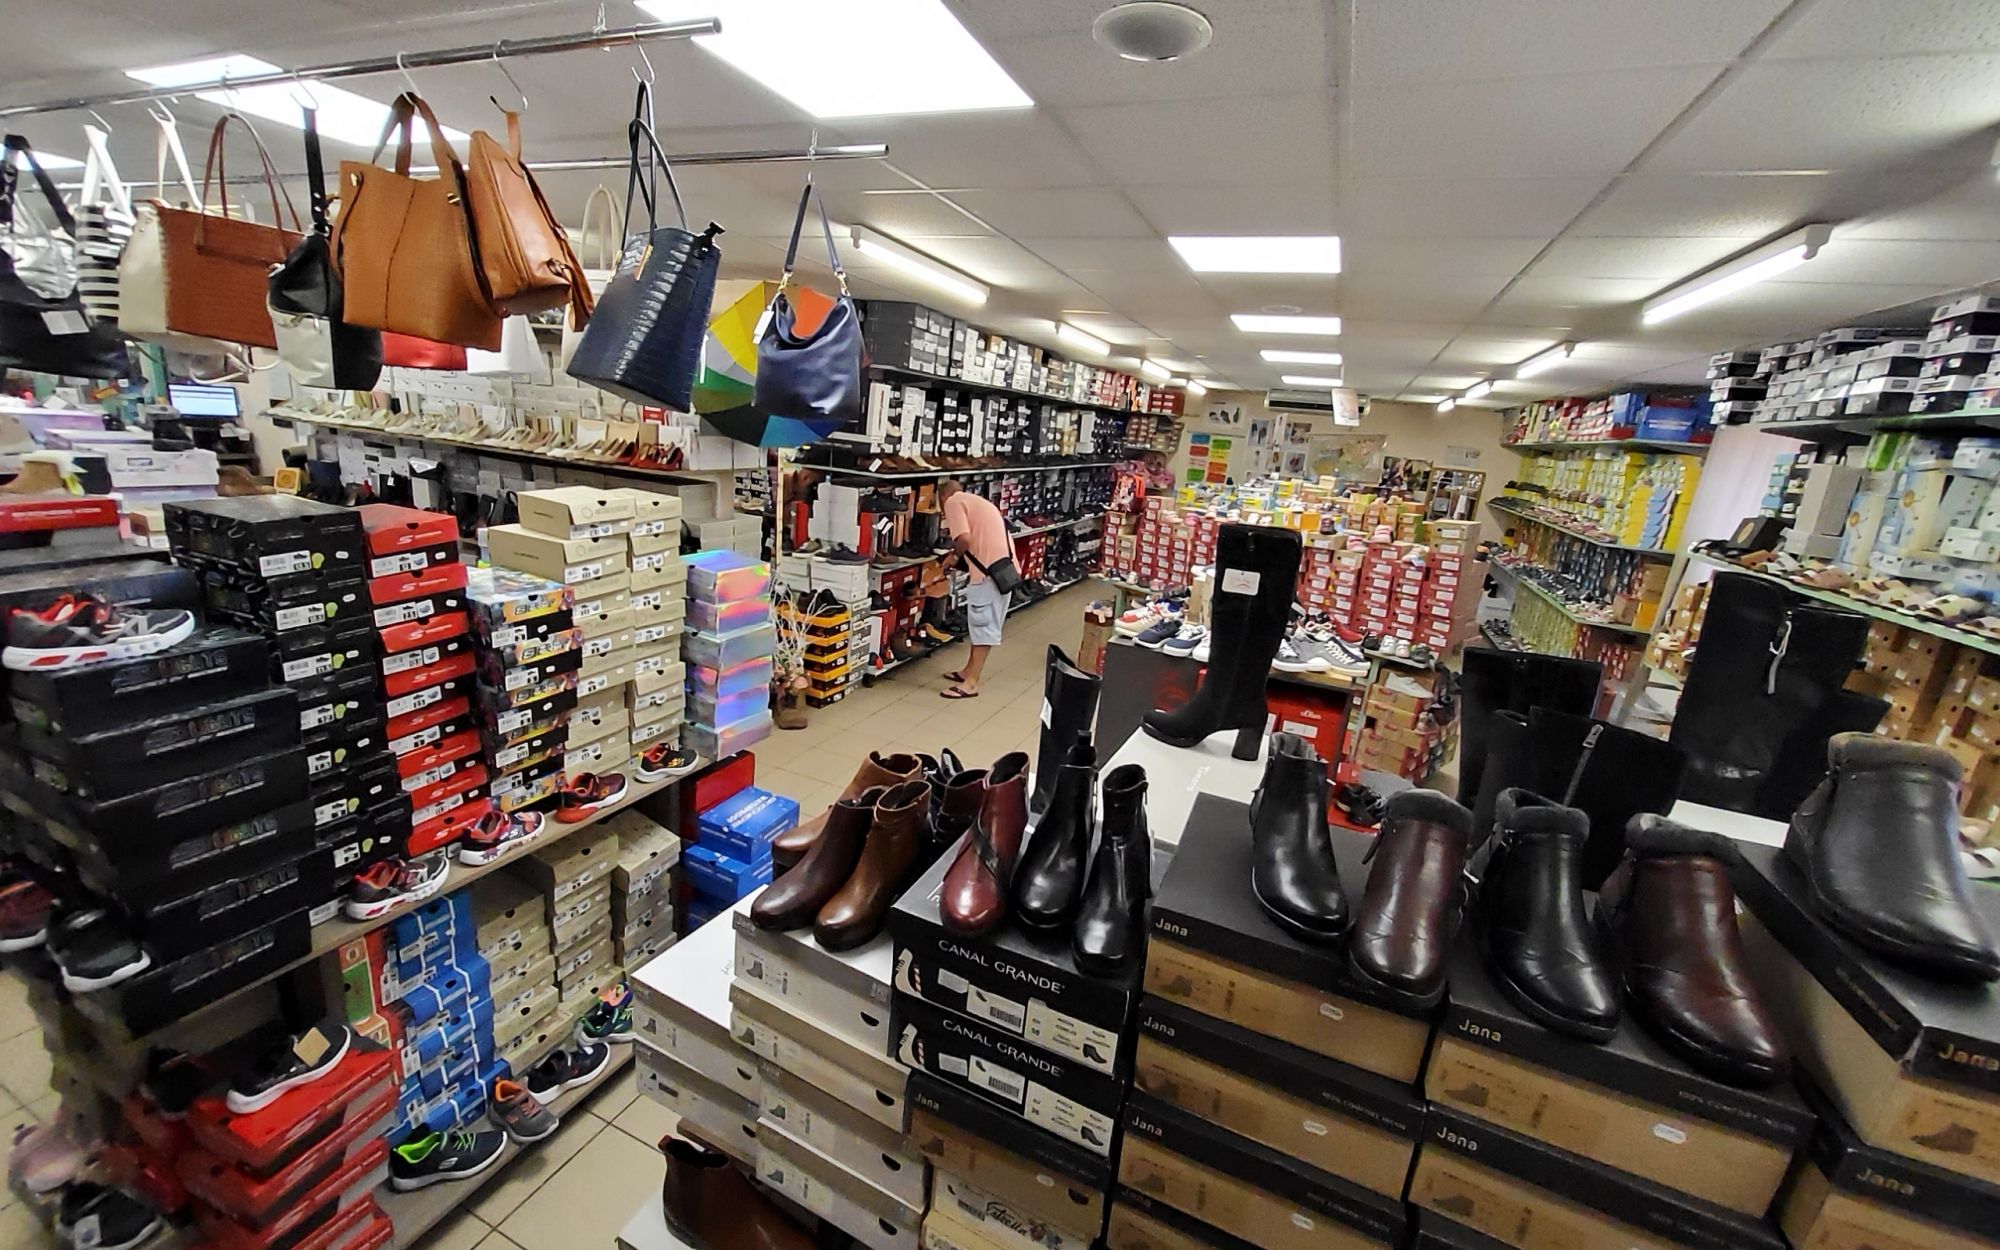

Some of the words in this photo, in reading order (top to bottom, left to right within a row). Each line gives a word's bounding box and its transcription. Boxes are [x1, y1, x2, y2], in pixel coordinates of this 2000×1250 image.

[1155, 918, 1189, 936] Jana
[938, 939, 989, 967] CANAL
[994, 961, 1062, 994] GRANDE
[1143, 1016, 1176, 1037] Jana
[1458, 1019, 1502, 1042] Jana
[942, 1019, 992, 1048] CANAL
[996, 1041, 1062, 1078] GRANDE
[1938, 1043, 2000, 1071] Jana
[915, 1092, 940, 1110] Jana
[1131, 1116, 1163, 1137] Jana
[1436, 1126, 1478, 1151] Jana
[1856, 1167, 1916, 1195] Jana
